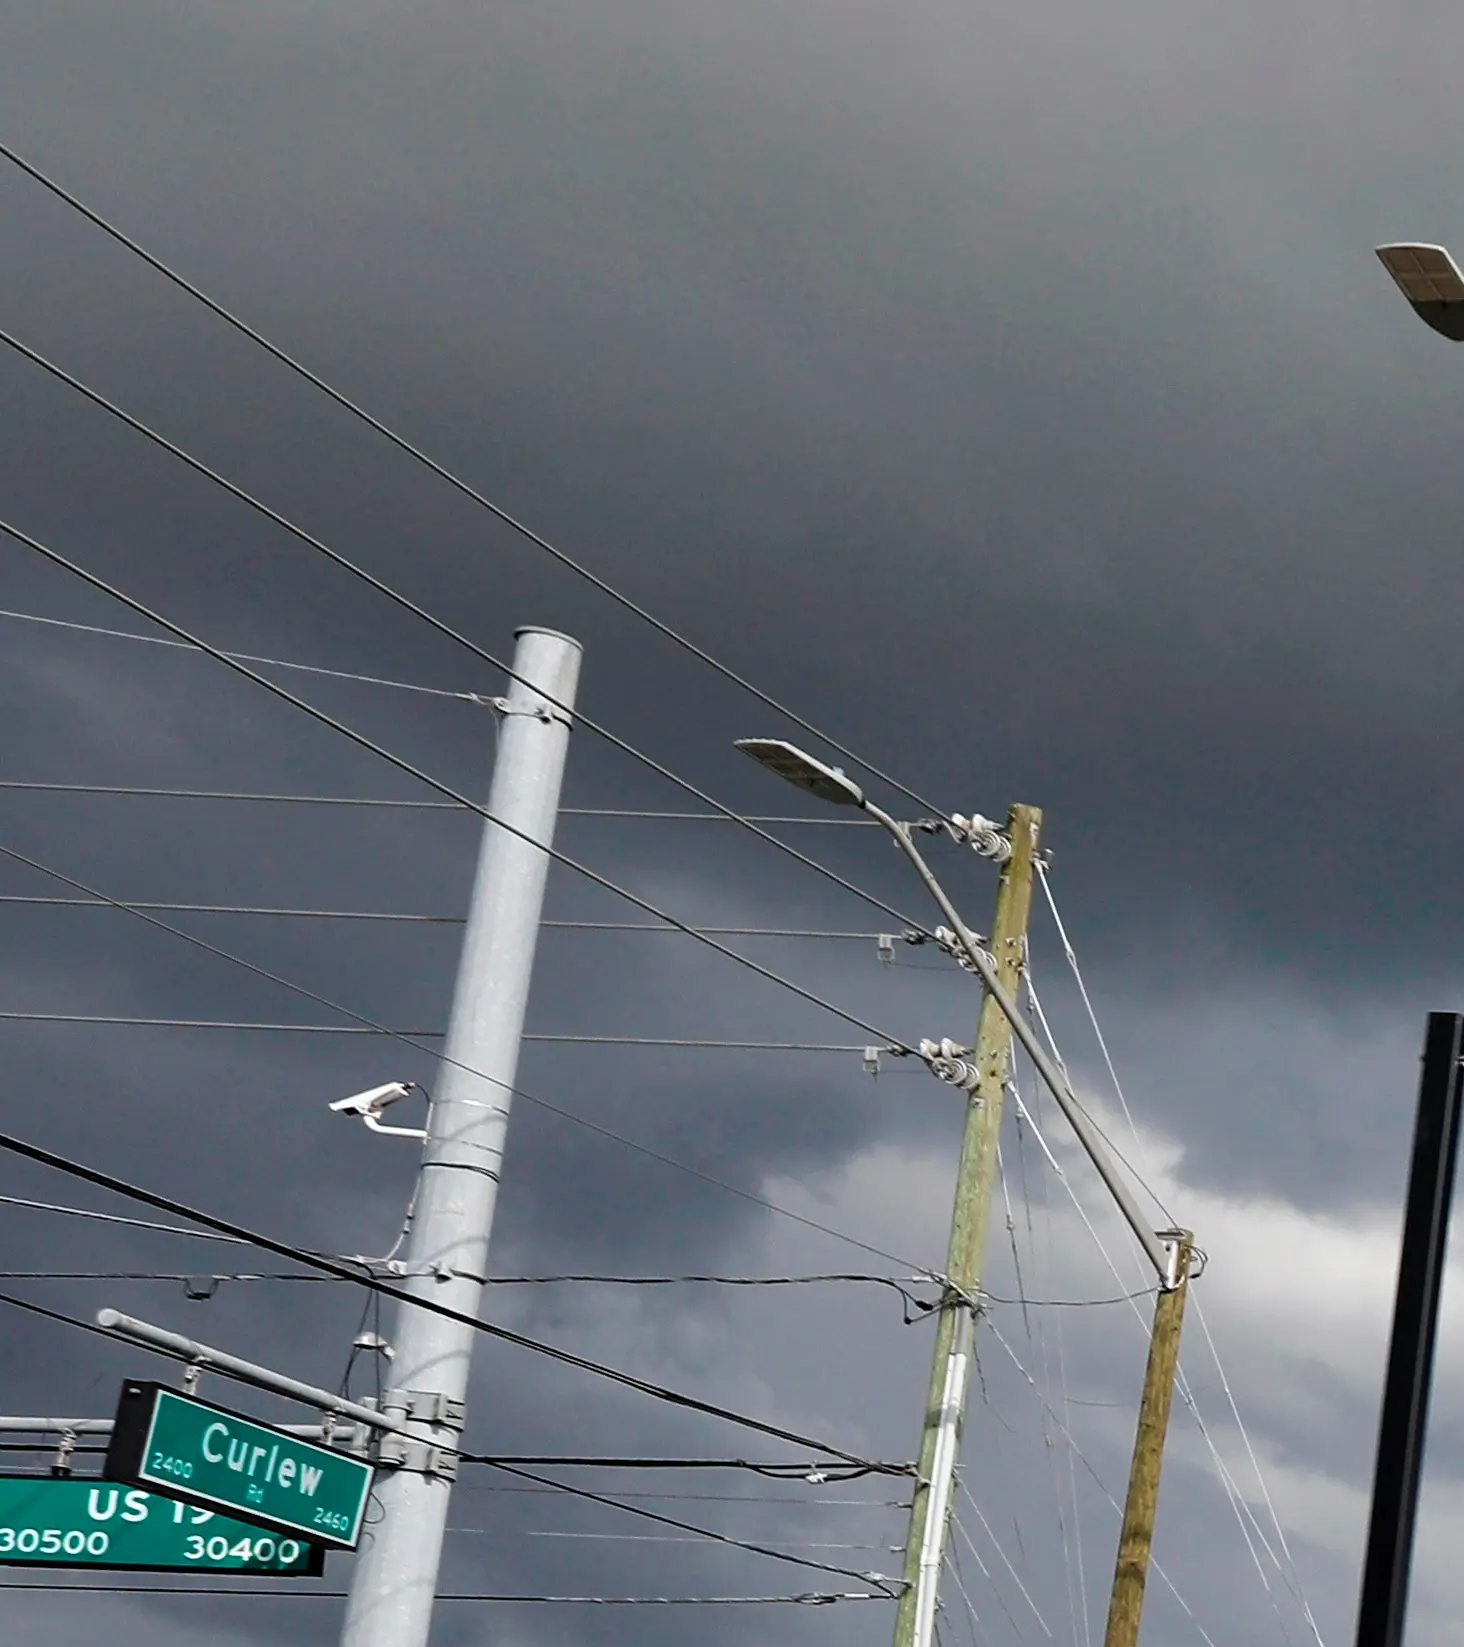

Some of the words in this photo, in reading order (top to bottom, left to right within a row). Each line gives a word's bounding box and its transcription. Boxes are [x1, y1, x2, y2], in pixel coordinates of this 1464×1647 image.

[152, 1452, 194, 1480] 2400
[202, 1421, 323, 1498] Curlew
[88, 1489, 150, 1523] US
[247, 1483, 264, 1504] Rd
[313, 1507, 349, 1532] 2460
[0, 1528, 110, 1556] 30500
[184, 1534, 300, 1564] 30400
